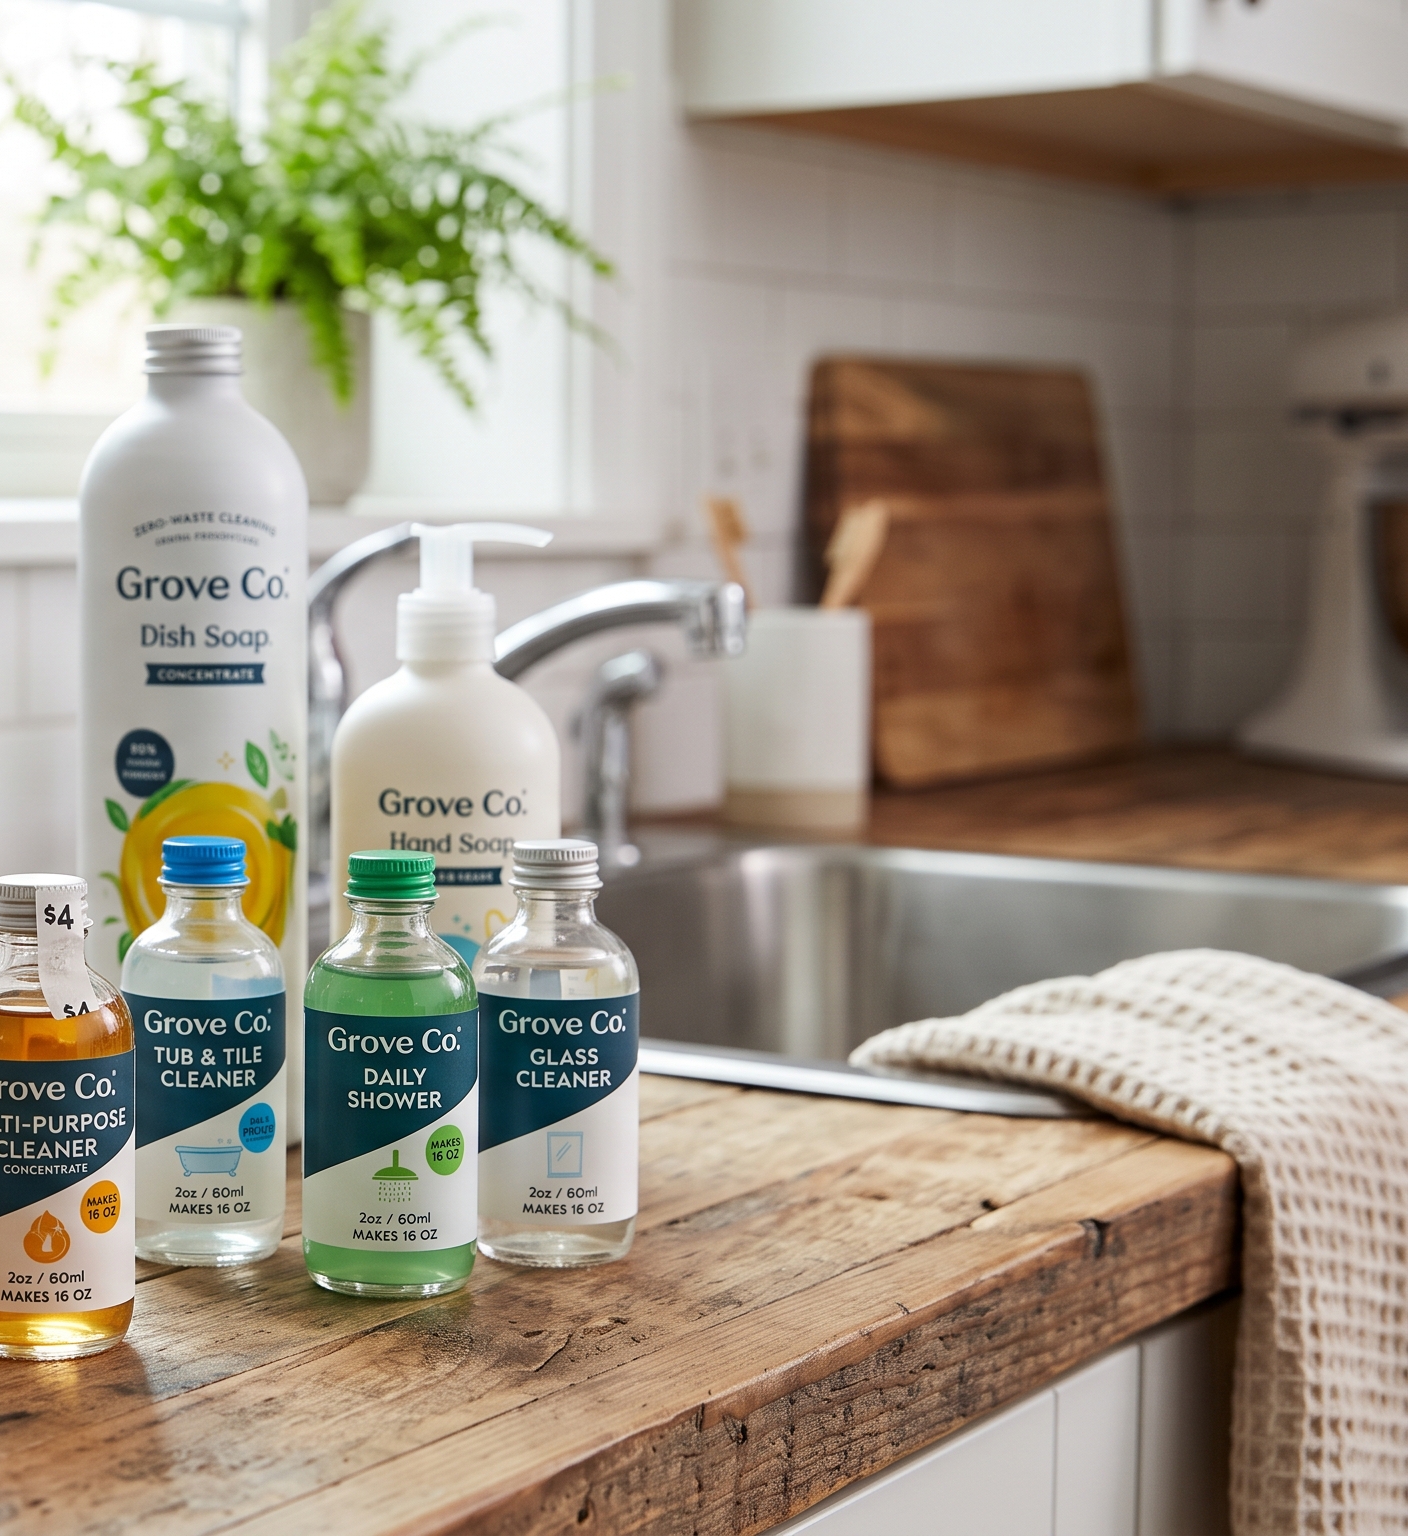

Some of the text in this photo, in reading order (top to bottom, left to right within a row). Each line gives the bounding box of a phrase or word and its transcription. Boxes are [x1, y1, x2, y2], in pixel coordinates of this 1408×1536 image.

[218, 512, 277, 537] CLEANING
[116, 565, 230, 601] Grove
[140, 624, 196, 648] Dish
[156, 668, 255, 682] CONCENTRATE
[378, 788, 473, 818] Grove
[390, 831, 515, 859] Hand Soap
[44, 903, 74, 930] $4
[143, 1009, 227, 1036] Grove
[498, 1009, 583, 1036] Grove
[327, 1026, 414, 1055] Grove
[153, 1046, 263, 1066] TUB & TILE
[530, 1048, 599, 1066] GLASS
[160, 1069, 257, 1089] CLEANER
[364, 1067, 427, 1086] DAILY
[516, 1069, 612, 1089] CLEANER
[347, 1090, 443, 1110] SHOWER
[430, 1137, 461, 1150] MAKES
[432, 1148, 460, 1161] 16 OZ
[3, 1162, 89, 1176] CONCENTRATE
[86, 1193, 118, 1208] MAKES
[175, 1185, 244, 1199] 2oz / 60ml
[529, 1185, 598, 1199] 2oz / 60ml
[87, 1205, 117, 1221] 16 OZ
[169, 1202, 251, 1215] MAKES 16 OZ
[522, 1202, 605, 1215] MAKES 16 OZ
[359, 1211, 431, 1225] 2oz / 60ml
[352, 1228, 438, 1242] MAKES 16 OZ
[7, 1269, 85, 1285] 2oz / 60ml
[0, 1288, 93, 1303] MAKES 16 OZ
